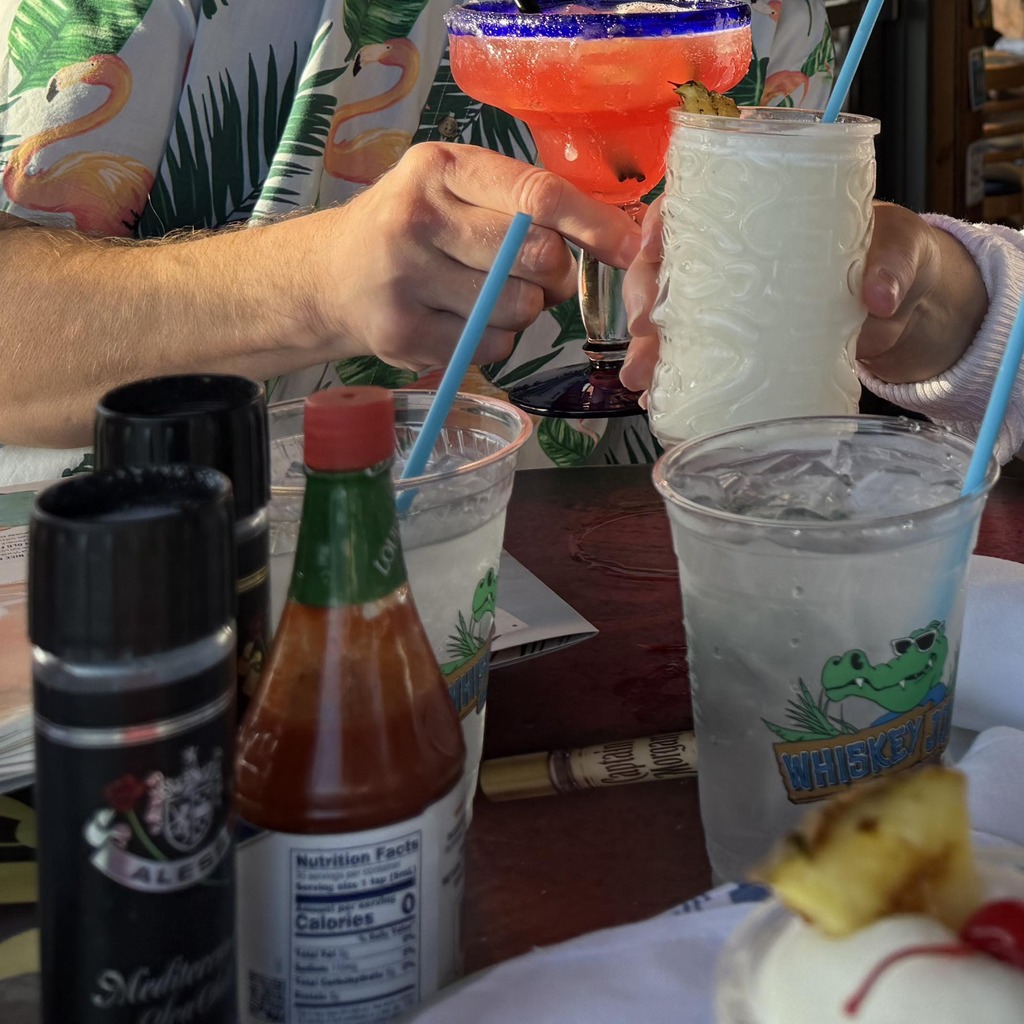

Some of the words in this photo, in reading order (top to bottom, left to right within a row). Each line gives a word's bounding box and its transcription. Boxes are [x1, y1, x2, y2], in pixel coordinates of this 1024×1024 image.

[594, 740, 649, 784] Captain
[648, 733, 699, 779] Morgan
[782, 714, 924, 791] WHISKEY
[296, 851, 371, 868] Nutrition
[375, 838, 418, 861] Facts
[296, 912, 375, 930] Calories
[402, 892, 416, 914] 0
